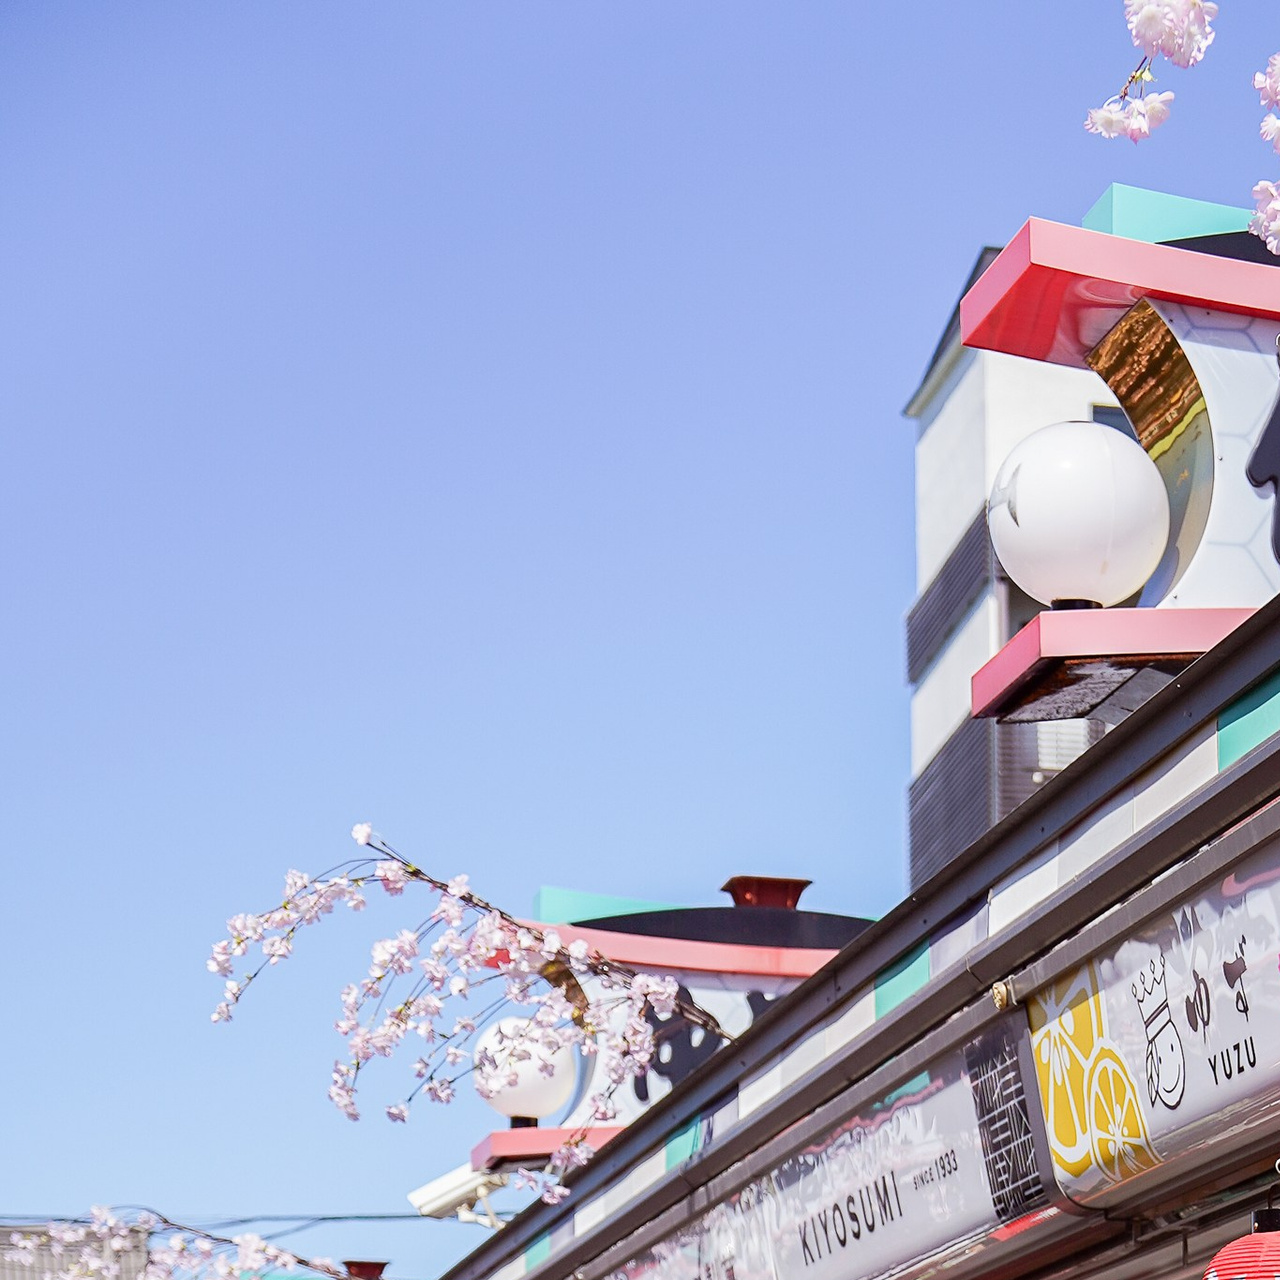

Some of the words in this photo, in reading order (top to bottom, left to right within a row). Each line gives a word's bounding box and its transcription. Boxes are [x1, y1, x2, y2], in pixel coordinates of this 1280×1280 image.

[1207, 1036, 1257, 1086] YUZU
[912, 1167, 935, 1190] SINCE
[934, 1149, 958, 1181] 1933
[798, 1170, 903, 1266] KIYOSUMI
